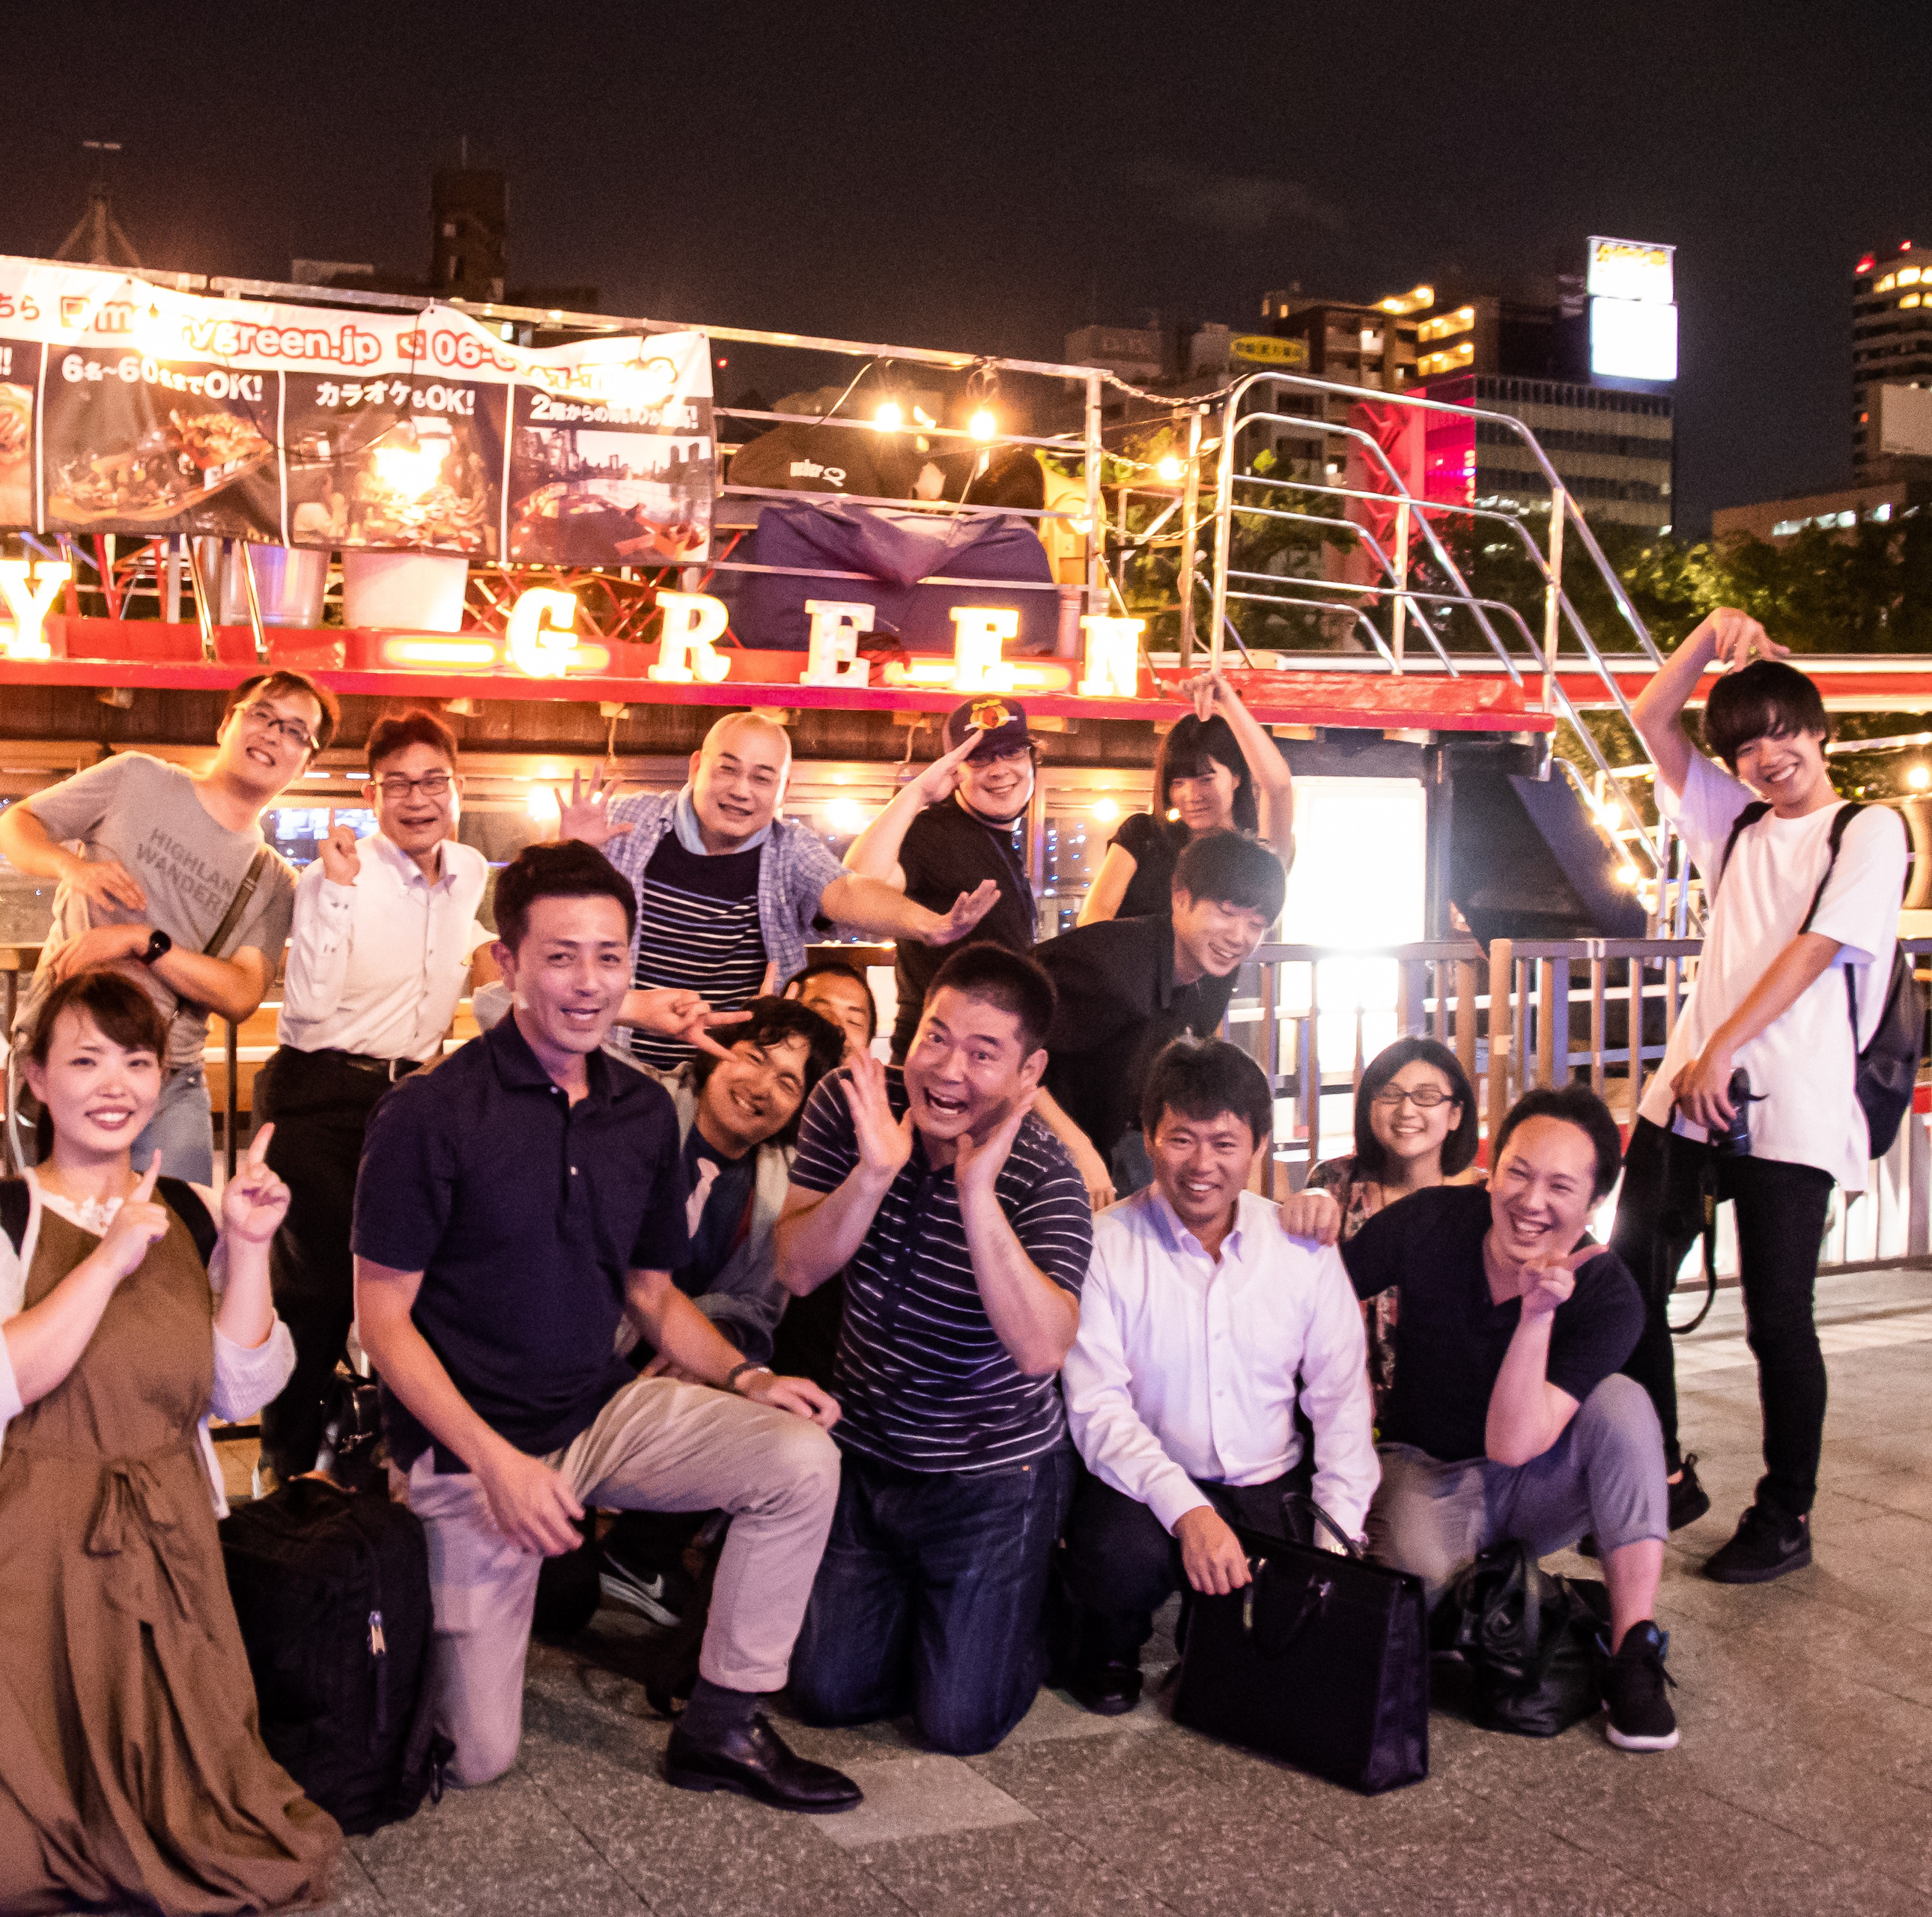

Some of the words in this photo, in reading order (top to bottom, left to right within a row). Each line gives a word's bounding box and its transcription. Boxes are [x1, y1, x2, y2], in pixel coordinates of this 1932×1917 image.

[95, 300, 381, 367] mygreen.jp
[315, 380, 476, 416] カラオケもOK!
[506, 587, 1146, 699] GREEN
[150, 828, 237, 897] HIGHLAN
